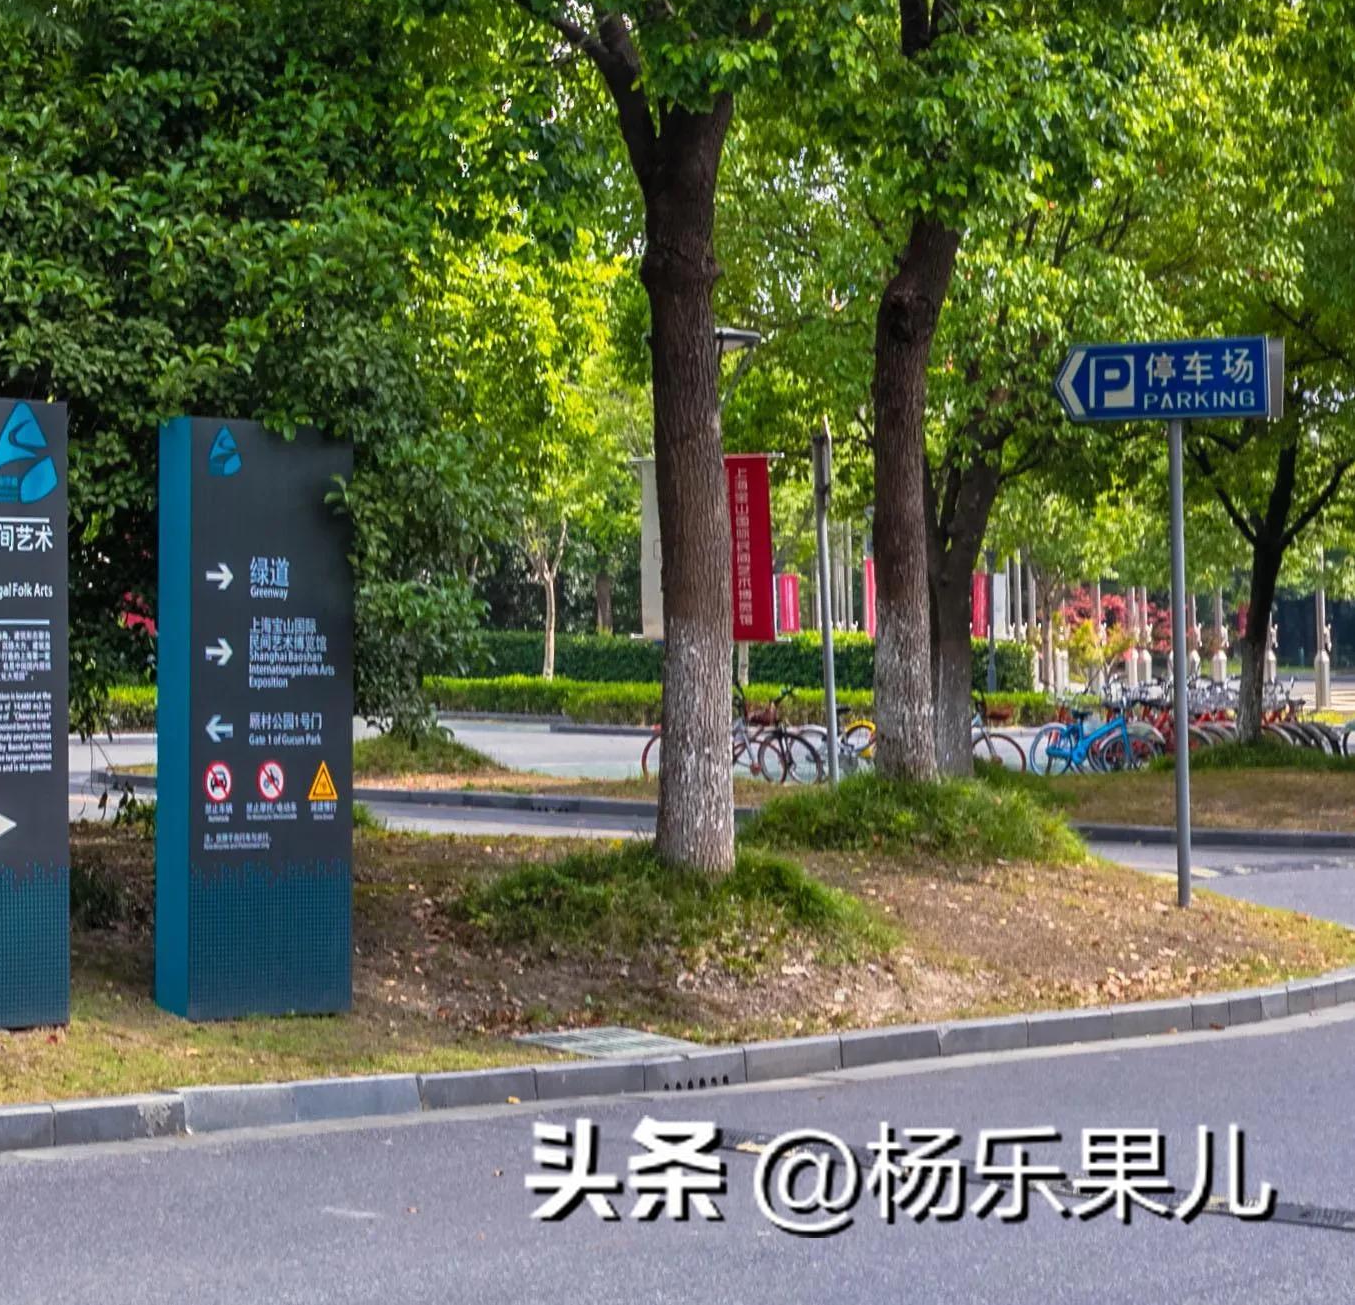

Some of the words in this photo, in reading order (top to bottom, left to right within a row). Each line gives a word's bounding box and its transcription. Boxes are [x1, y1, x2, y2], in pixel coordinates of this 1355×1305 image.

[1145, 348, 1254, 388] 停车场
[1144, 389, 1256, 410] PARKING
[250, 556, 290, 587] 绿道
[13, 583, 32, 597] Folk
[34, 583, 53, 598] Arts
[250, 586, 288, 600] Greenway
[249, 617, 316, 635] 上海宝山国际
[249, 634, 327, 652] 民间艺术博览馆
[249, 652, 287, 664] Shanghai
[288, 652, 323, 662] Baoshan
[303, 664, 319, 675] Folk
[320, 664, 335, 676] Arts
[249, 677, 288, 690] Exposition
[249, 712, 323, 731] 顾村公园1号门
[249, 734, 266, 745] Gate
[268, 734, 272, 745] 1
[273, 734, 282, 745] of
[306, 734, 322, 746] Park
